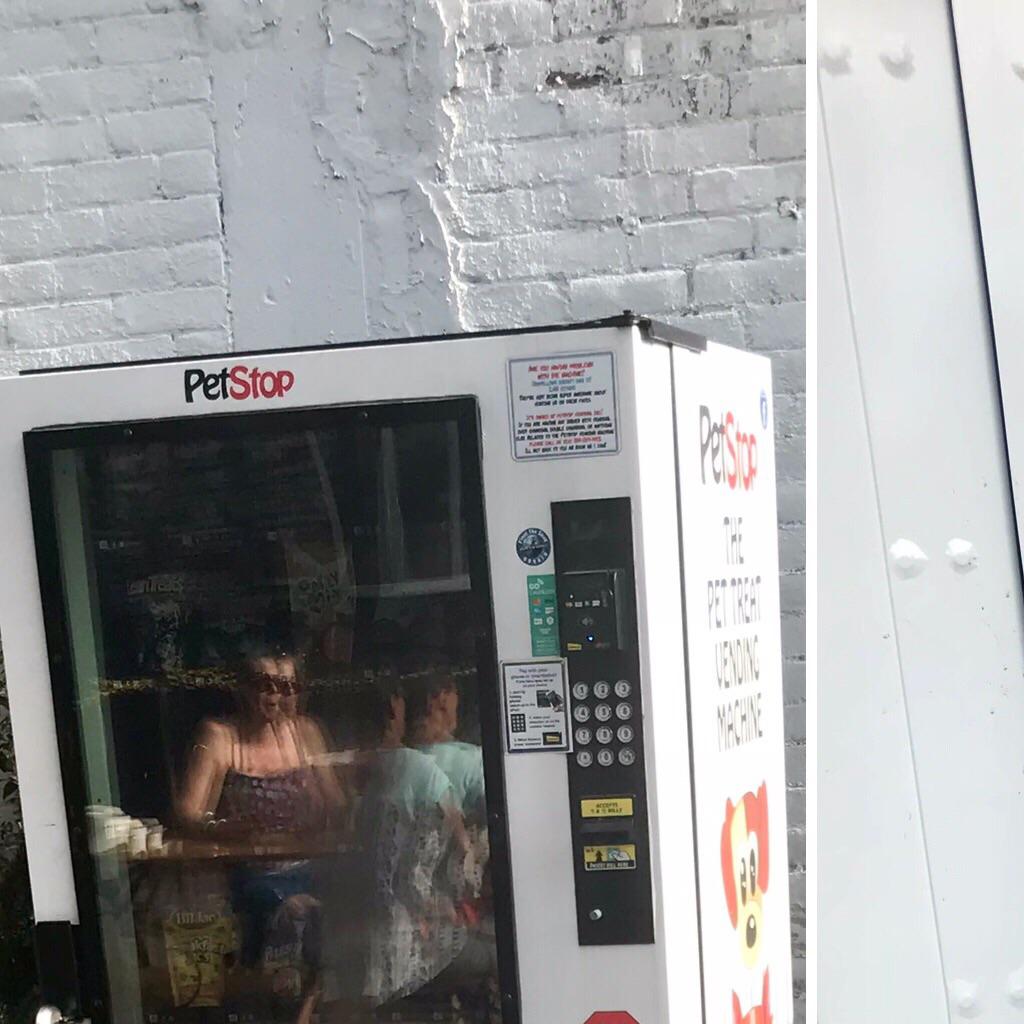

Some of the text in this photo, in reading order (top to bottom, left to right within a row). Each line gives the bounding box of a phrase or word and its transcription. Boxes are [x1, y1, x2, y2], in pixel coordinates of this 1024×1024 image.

[184, 365, 294, 403] PetStop
[699, 405, 757, 491] PetStop
[723, 516, 744, 565] THE
[707, 575, 761, 631] PET TREAT
[715, 634, 760, 689] VENDING
[717, 693, 763, 752] MACHINE
